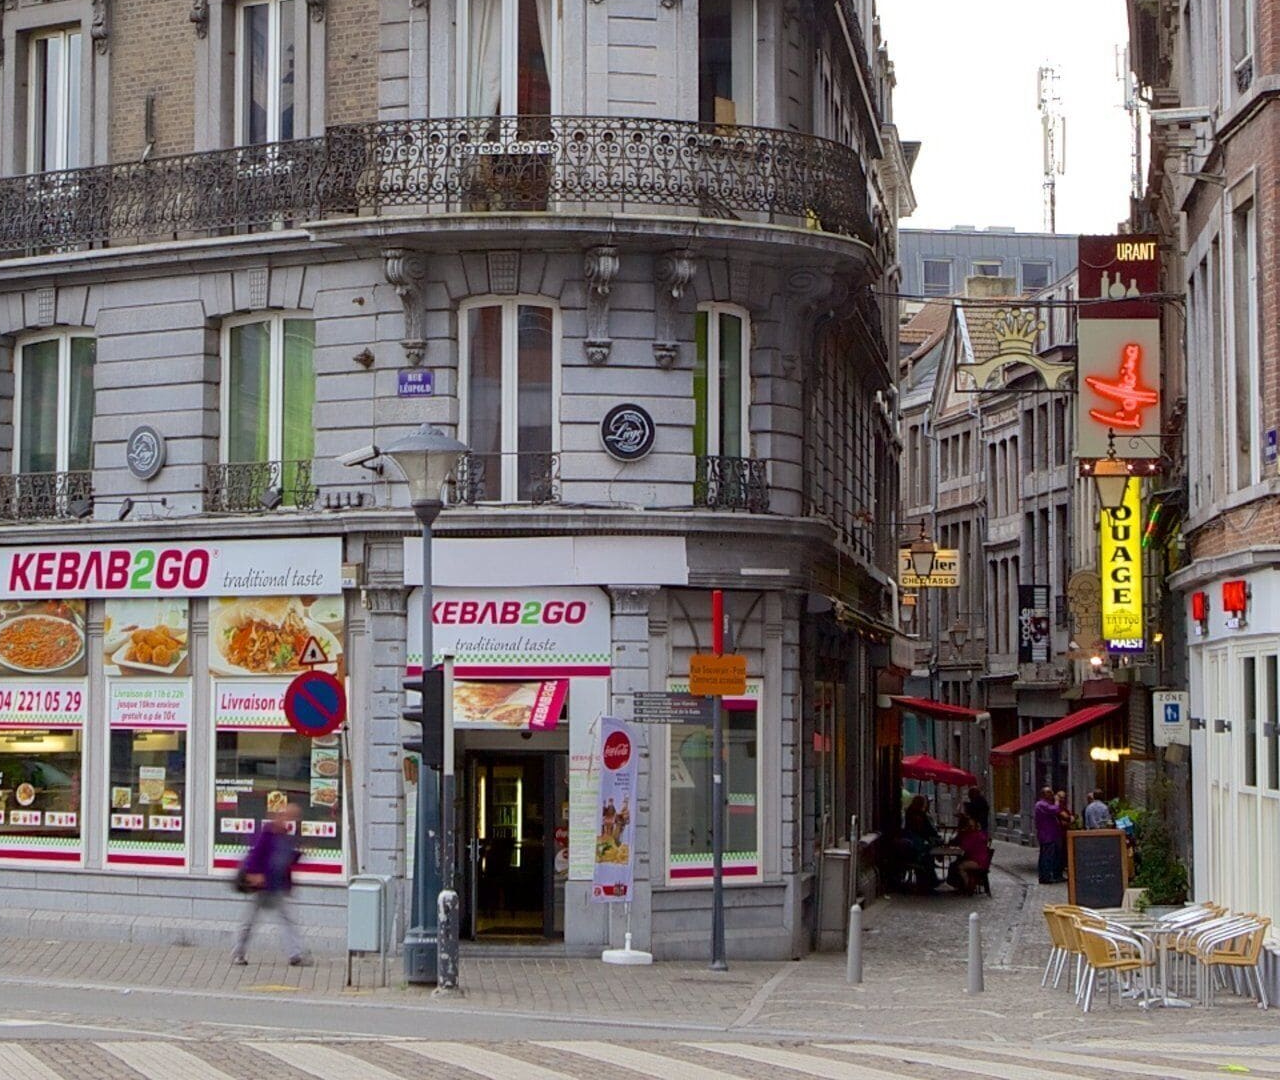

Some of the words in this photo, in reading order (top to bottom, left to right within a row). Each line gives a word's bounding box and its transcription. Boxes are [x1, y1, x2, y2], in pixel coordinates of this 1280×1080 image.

[1116, 242, 1156, 261] URANT
[903, 558, 957, 571] Jler
[1110, 506, 1132, 604] OUAGE
[8, 548, 211, 592] KEBAB2GO
[223, 567, 290, 589] traditional
[291, 570, 324, 588] taste
[431, 601, 587, 624] KEBAB2GO
[456, 636, 522, 652] traditional
[524, 638, 556, 651] taste
[221, 693, 272, 711] Livraison
